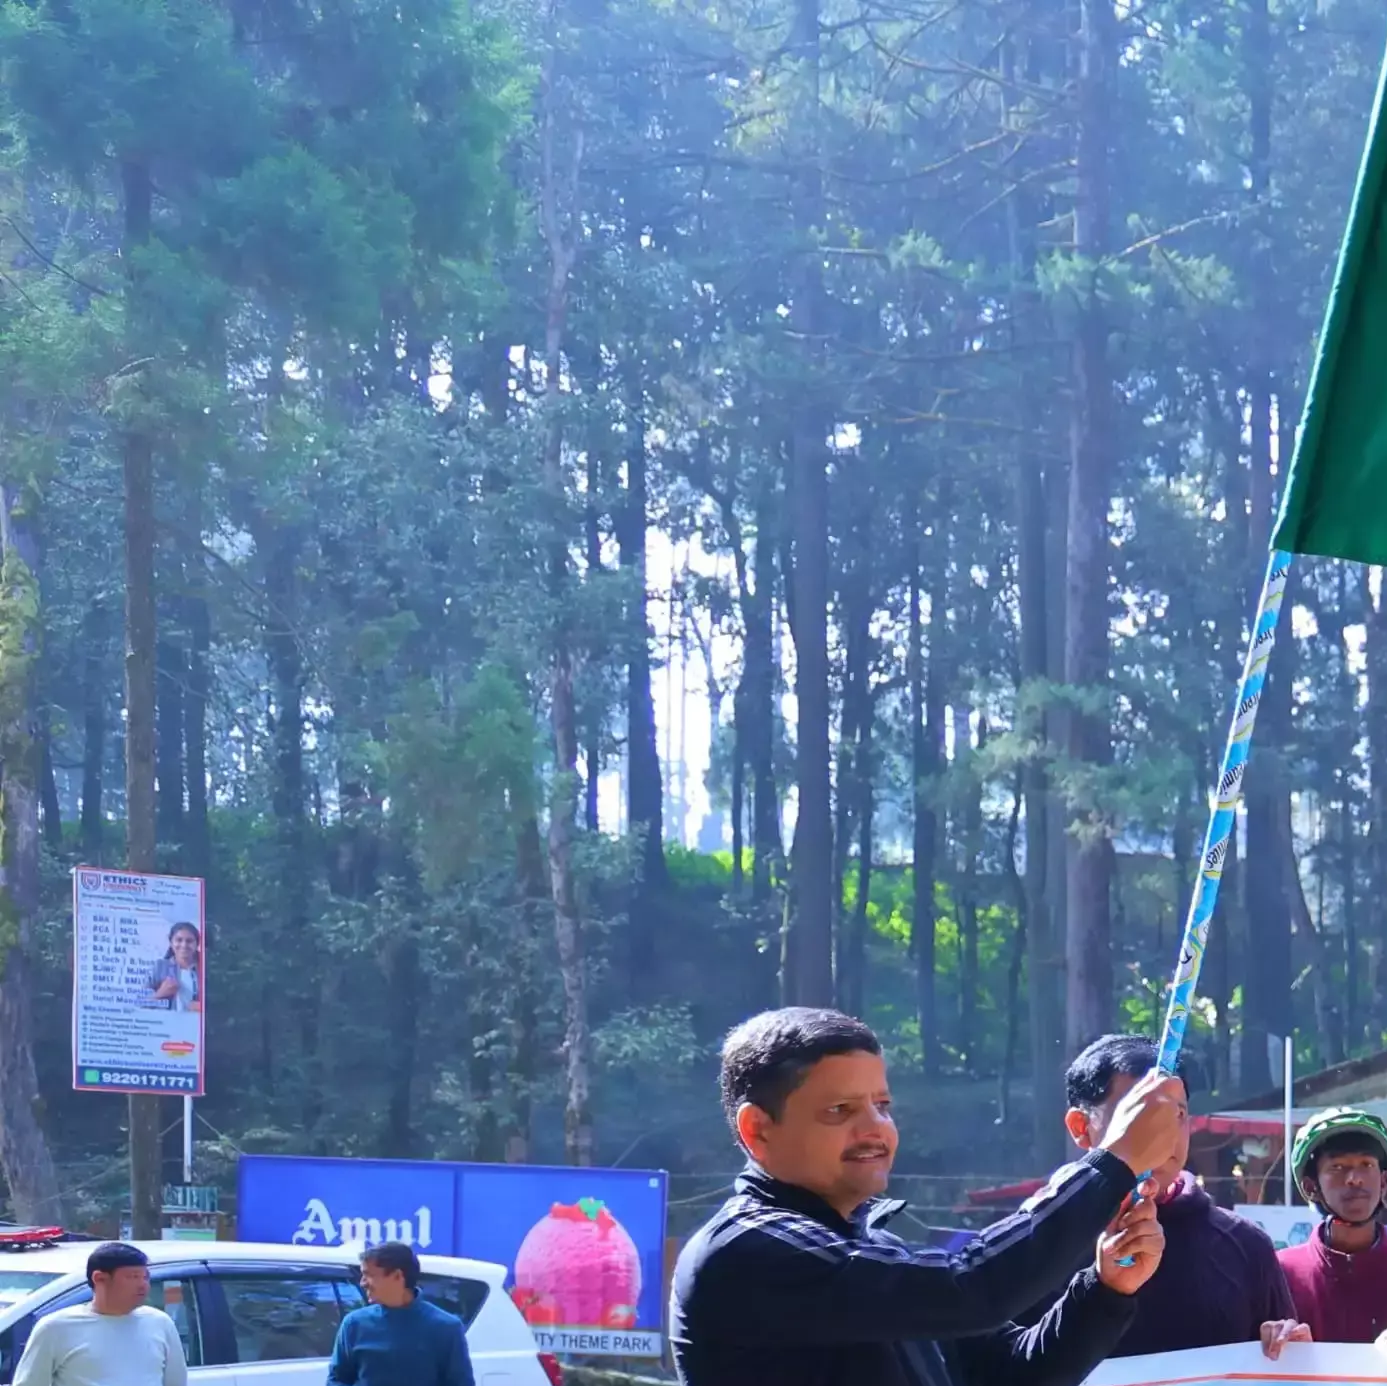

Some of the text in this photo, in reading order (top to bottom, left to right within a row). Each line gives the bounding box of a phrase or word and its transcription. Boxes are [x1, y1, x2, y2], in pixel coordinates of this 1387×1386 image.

[292, 1198, 434, 1250] Amul
[560, 1332, 610, 1351] THEME
[613, 1335, 653, 1352] PARK
